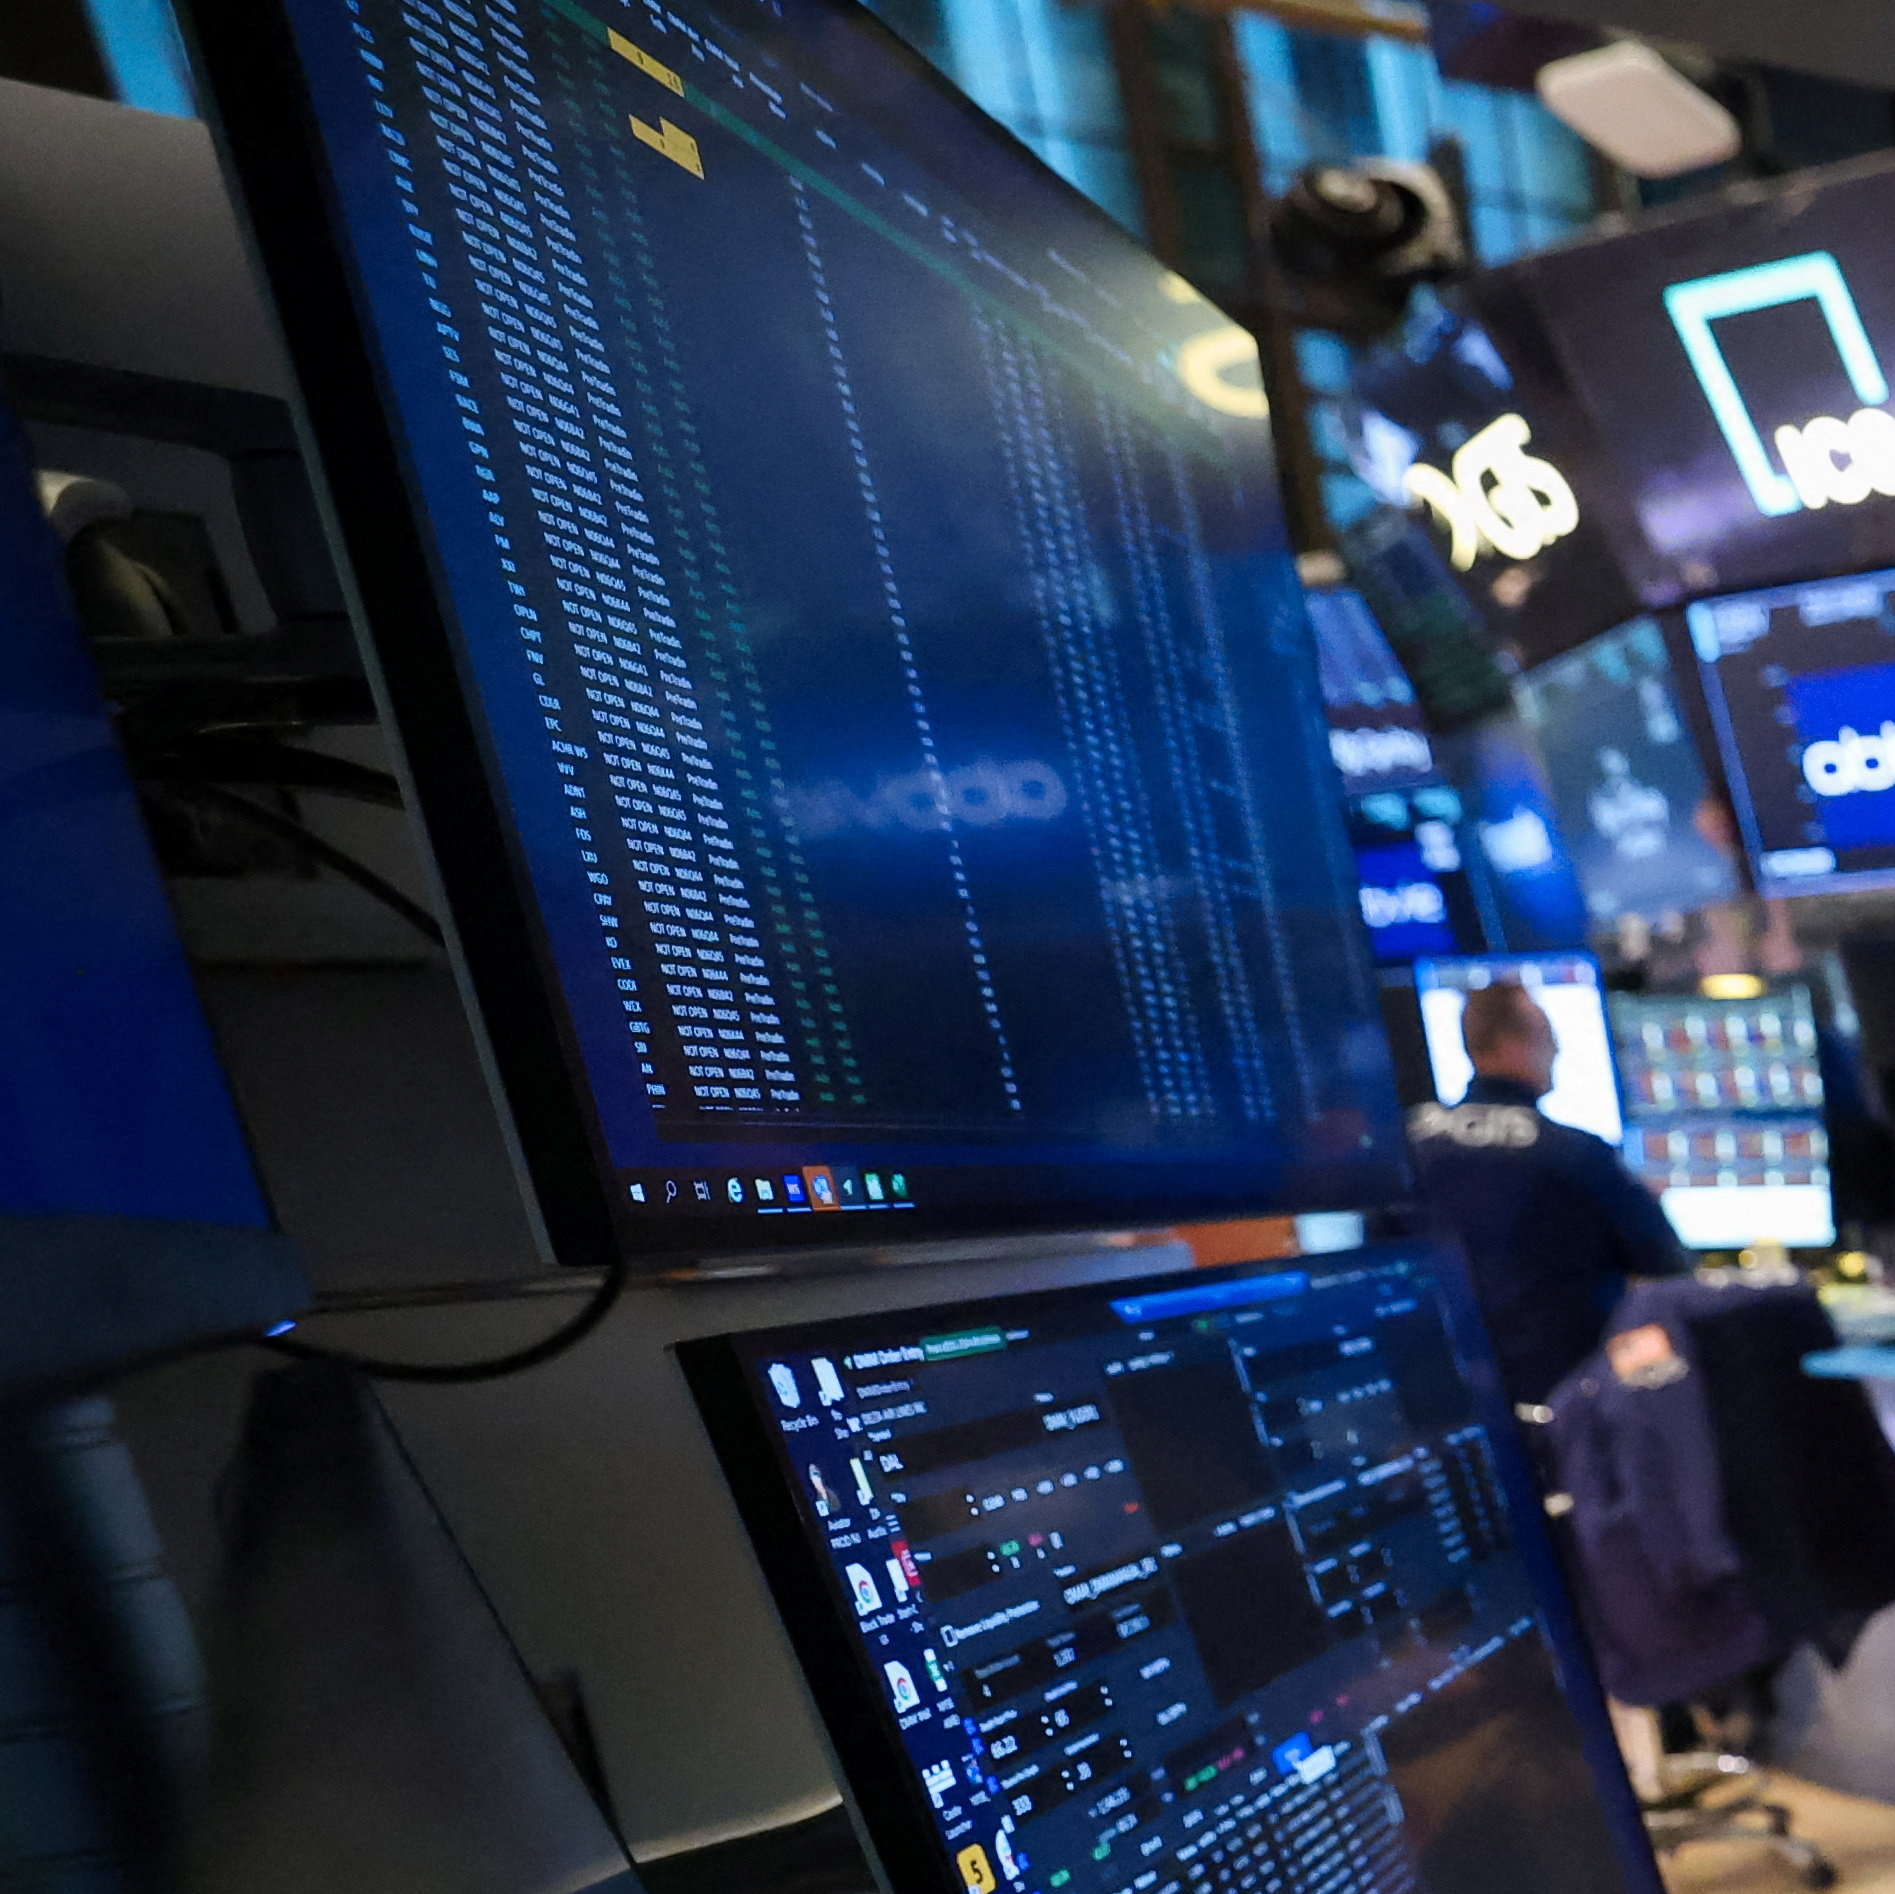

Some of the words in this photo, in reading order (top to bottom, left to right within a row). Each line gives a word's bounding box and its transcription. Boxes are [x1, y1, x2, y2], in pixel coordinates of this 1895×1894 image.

[568, 621, 585, 636] NOT
[586, 627, 608, 644] OPEN
[574, 643, 591, 658] NOT
[592, 649, 614, 665] OPEN
[580, 665, 597, 680] NOT
[597, 670, 619, 687] OPEN
[586, 687, 602, 702] NOT
[603, 692, 625, 708] OPEN
[592, 709, 608, 723] NOT
[609, 713, 631, 729] OPEN
[597, 731, 614, 744] NOT
[615, 735, 637, 751] OPEN
[603, 752, 620, 766] NOT
[620, 756, 642, 772] OPEN
[609, 774, 626, 787] NOT
[626, 778, 648, 793] OPEN
[615, 795, 631, 808] NOT
[632, 799, 653, 813] OPEN
[621, 817, 637, 830] NOT
[637, 820, 659, 834] OPEN
[626, 838, 643, 851] NOT
[643, 841, 664, 855] OPEN
[632, 859, 649, 872] NOT
[649, 862, 670, 876] OPEN
[638, 880, 654, 892] NOT
[654, 883, 675, 896] OPEN
[644, 901, 660, 913] NOT
[660, 903, 681, 917] OPEN
[649, 922, 665, 934] NOT
[666, 924, 686, 937] OPEN
[655, 943, 671, 955] NOT
[671, 945, 692, 958] OPEN
[660, 963, 676, 975] NOT
[677, 964, 698, 977] OPEN
[666, 984, 682, 996] NOT
[682, 985, 703, 998] OPEN
[672, 1005, 688, 1016] NOT
[688, 1006, 708, 1018] OPEN
[677, 1025, 693, 1037] NOT
[693, 1026, 714, 1038] OPEN
[683, 1045, 699, 1056] NOT
[698, 1046, 719, 1058] OPEN
[689, 1065, 704, 1077] NOT
[704, 1066, 724, 1078] OPEN
[694, 1086, 710, 1097] NOT
[709, 1086, 730, 1098] OPEN
